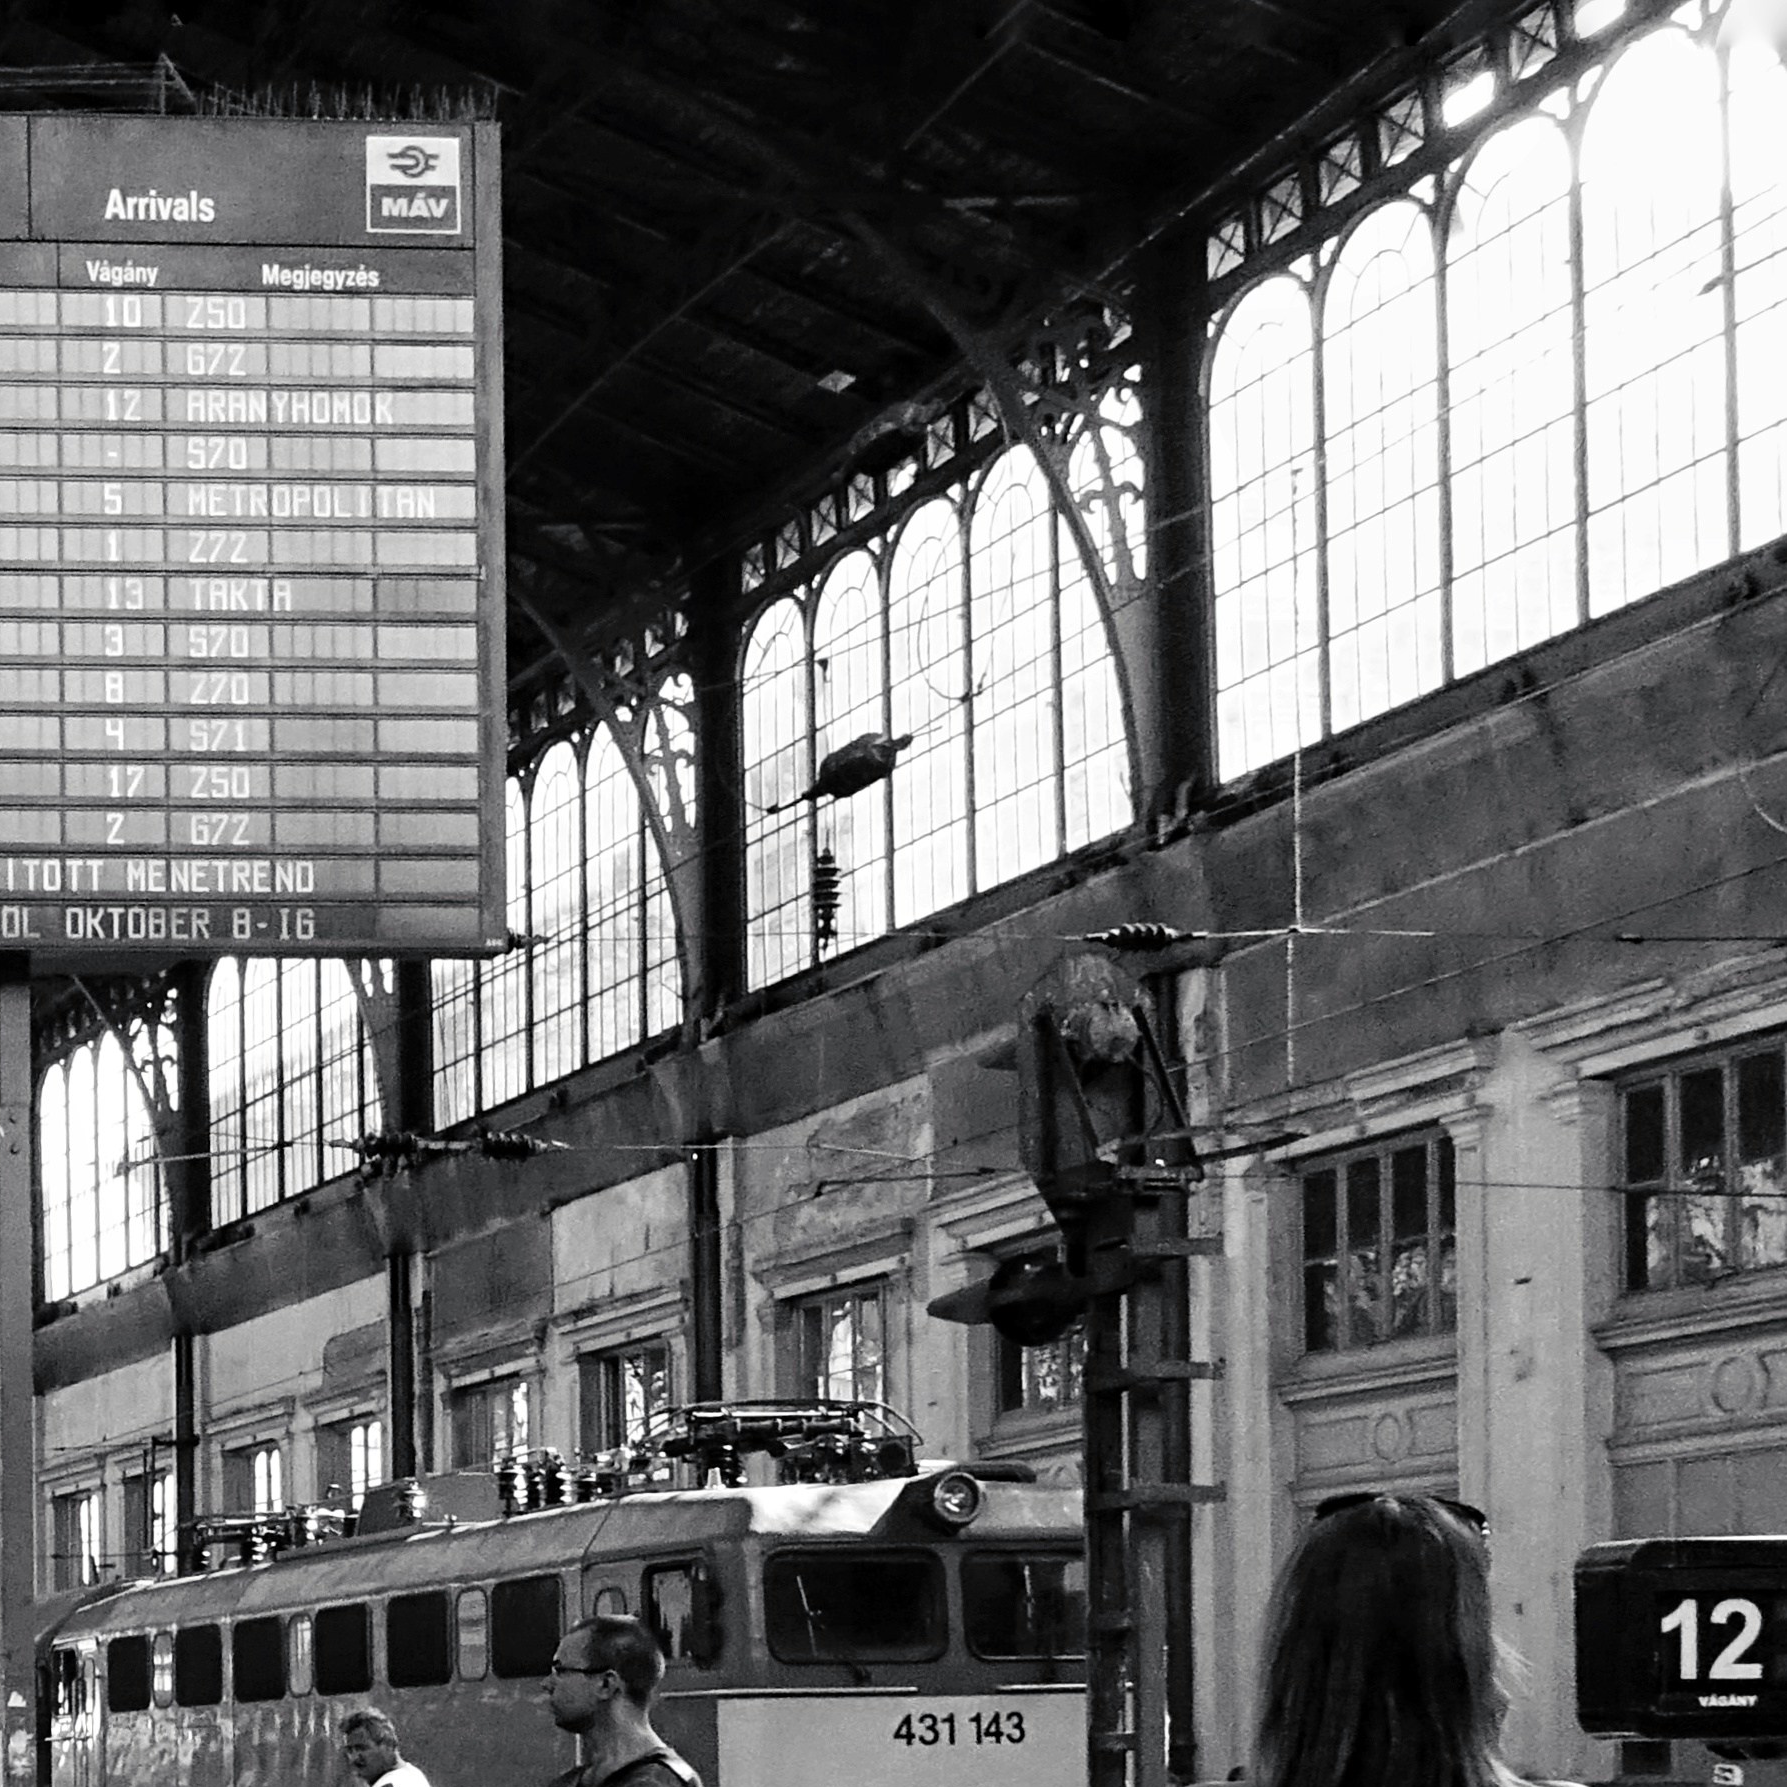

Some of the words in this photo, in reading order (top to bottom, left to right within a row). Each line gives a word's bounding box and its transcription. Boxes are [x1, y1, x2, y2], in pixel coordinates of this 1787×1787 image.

[105, 189, 214, 221] Arrivals
[382, 192, 449, 218] MÁV
[86, 260, 158, 286] Vágány
[262, 264, 379, 290] Megjegyzés
[106, 294, 143, 328] 10
[104, 341, 122, 375] 2
[107, 388, 143, 422] 12
[187, 390, 392, 426] ARANYHOMOK
[188, 436, 248, 470] S70
[104, 482, 123, 515] 5
[188, 483, 434, 520] METROPOLITAN
[107, 529, 123, 562] 1
[108, 576, 144, 610] 13
[188, 577, 290, 611] TAKTA
[105, 623, 123, 656] 3
[189, 624, 249, 658] S70
[105, 670, 123, 703] 8
[105, 717, 124, 750] 4
[189, 718, 250, 751] S71
[108, 764, 145, 798] 17
[106, 811, 124, 844] 2
[127, 859, 314, 893] MENETREND
[1661, 1599, 1763, 1679] 12
[894, 1713, 955, 1746] 431
[969, 1712, 1025, 1744] 143
